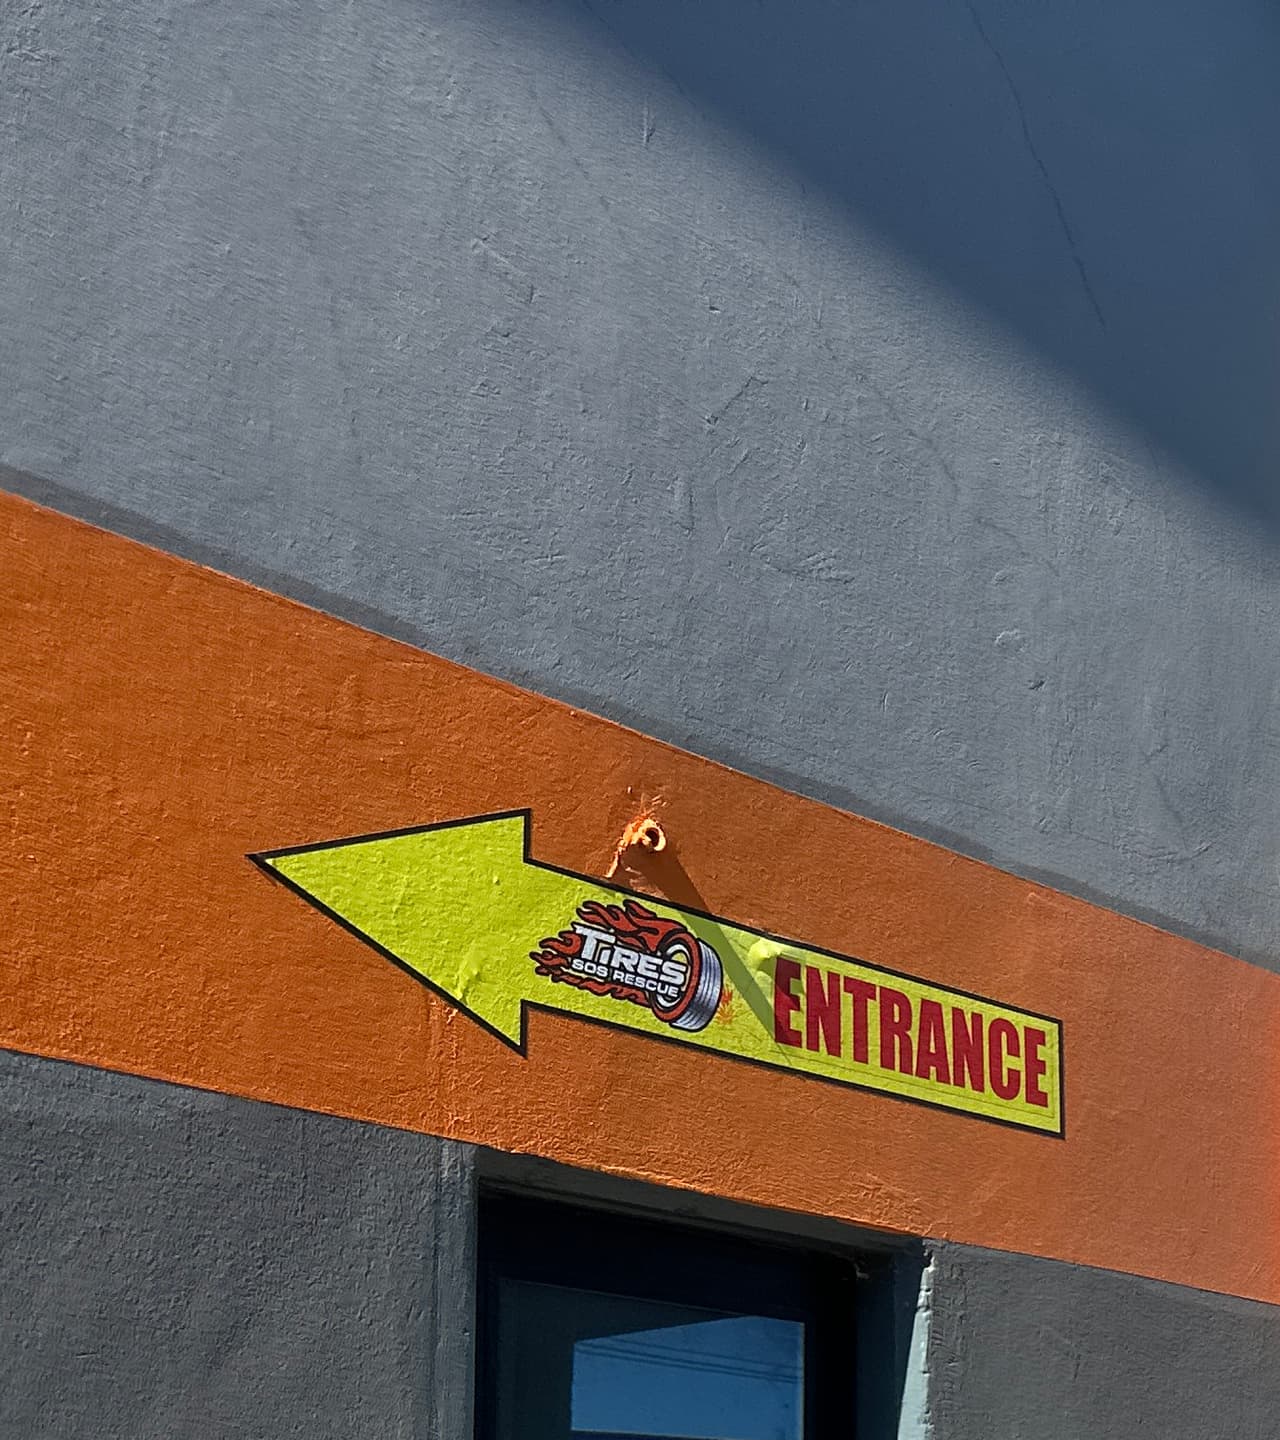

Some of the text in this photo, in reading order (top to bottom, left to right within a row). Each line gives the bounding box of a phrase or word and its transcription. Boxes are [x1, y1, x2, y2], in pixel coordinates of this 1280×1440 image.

[571, 958, 679, 998] SOS RESCUE
[773, 956, 1049, 1108] ENTRANCE
